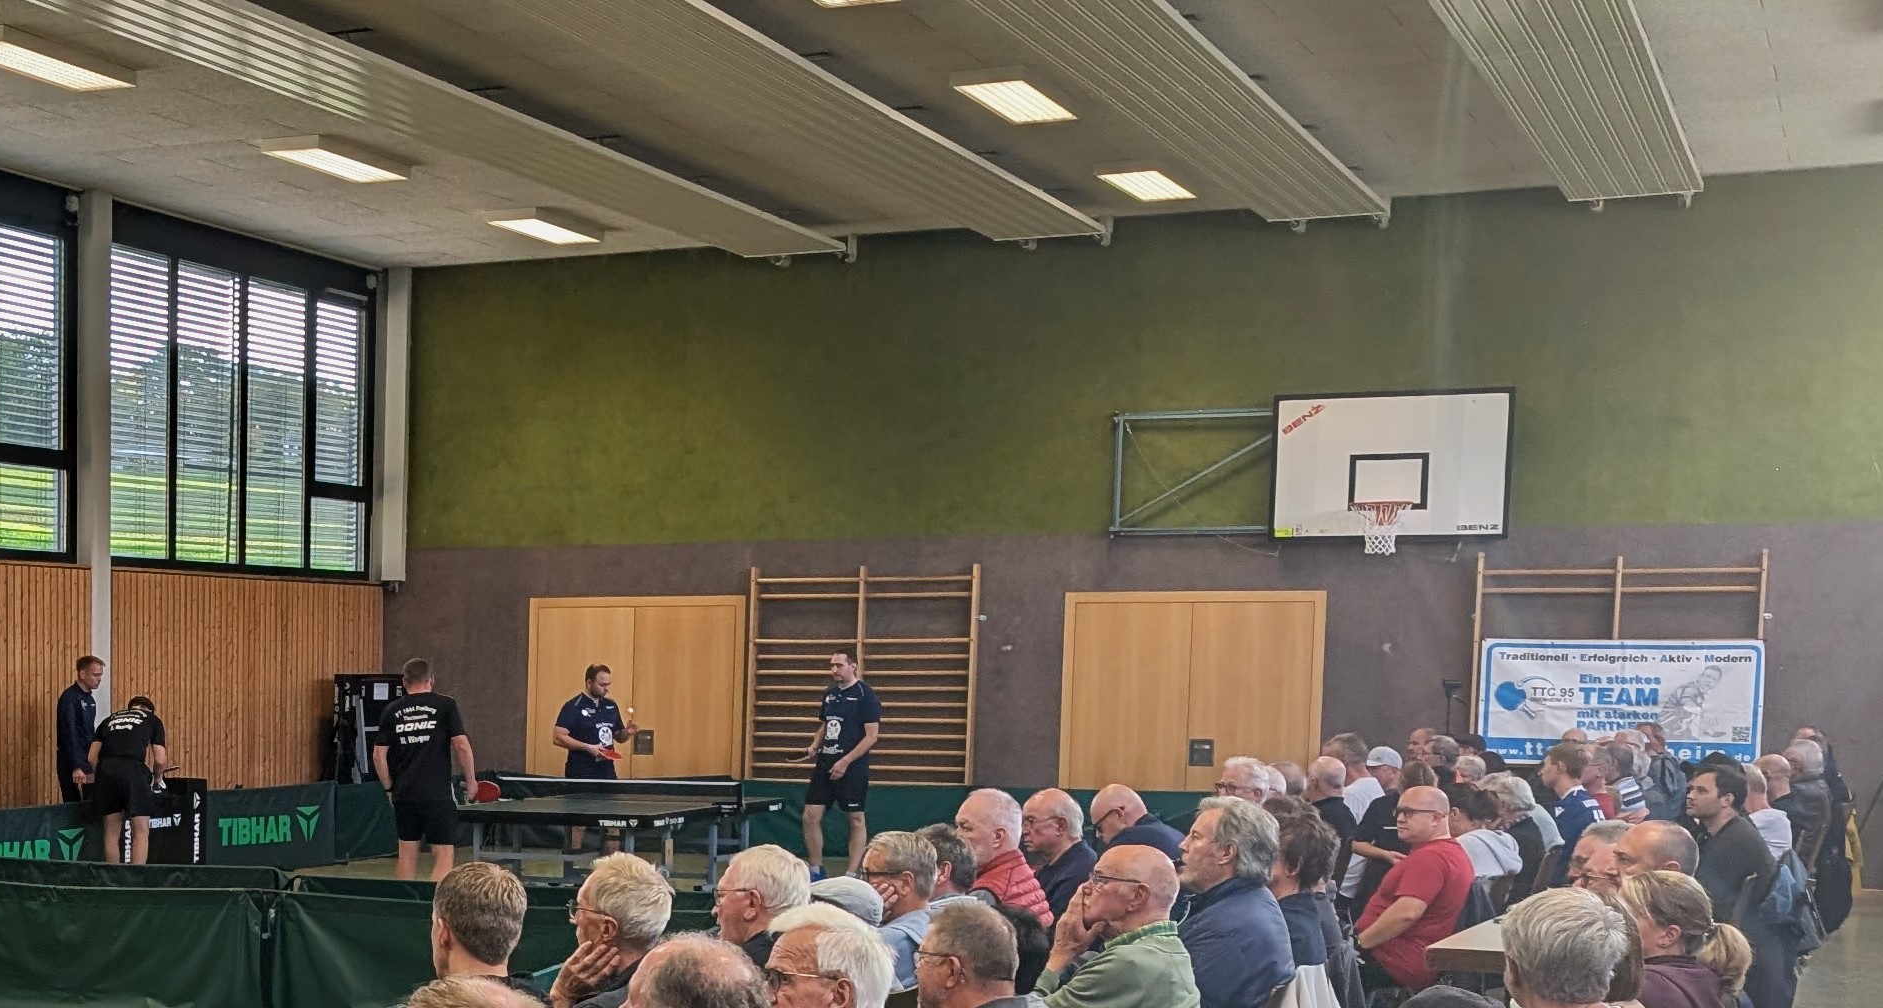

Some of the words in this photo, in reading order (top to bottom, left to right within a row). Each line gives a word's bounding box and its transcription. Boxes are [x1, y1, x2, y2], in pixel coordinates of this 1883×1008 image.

[1499, 652, 1568, 662] Traditionell
[1580, 653, 1648, 664] Erfolgreich
[1660, 653, 1692, 663] Aktiv
[1704, 654, 1752, 663] Modern
[1579, 674, 1602, 685] Ein
[1606, 674, 1662, 685] starkes
[1531, 686, 1556, 697] TTC
[1559, 687, 1575, 698] 95
[1579, 687, 1659, 707] TEAM
[1577, 709, 1600, 720] mit
[1604, 710, 1659, 720] starken
[396, 720, 437, 733] DONIC
[1576, 720, 1637, 732] PARTNE
[219, 815, 292, 847] TIBHAR
[193, 812, 201, 864] TIBHAR
